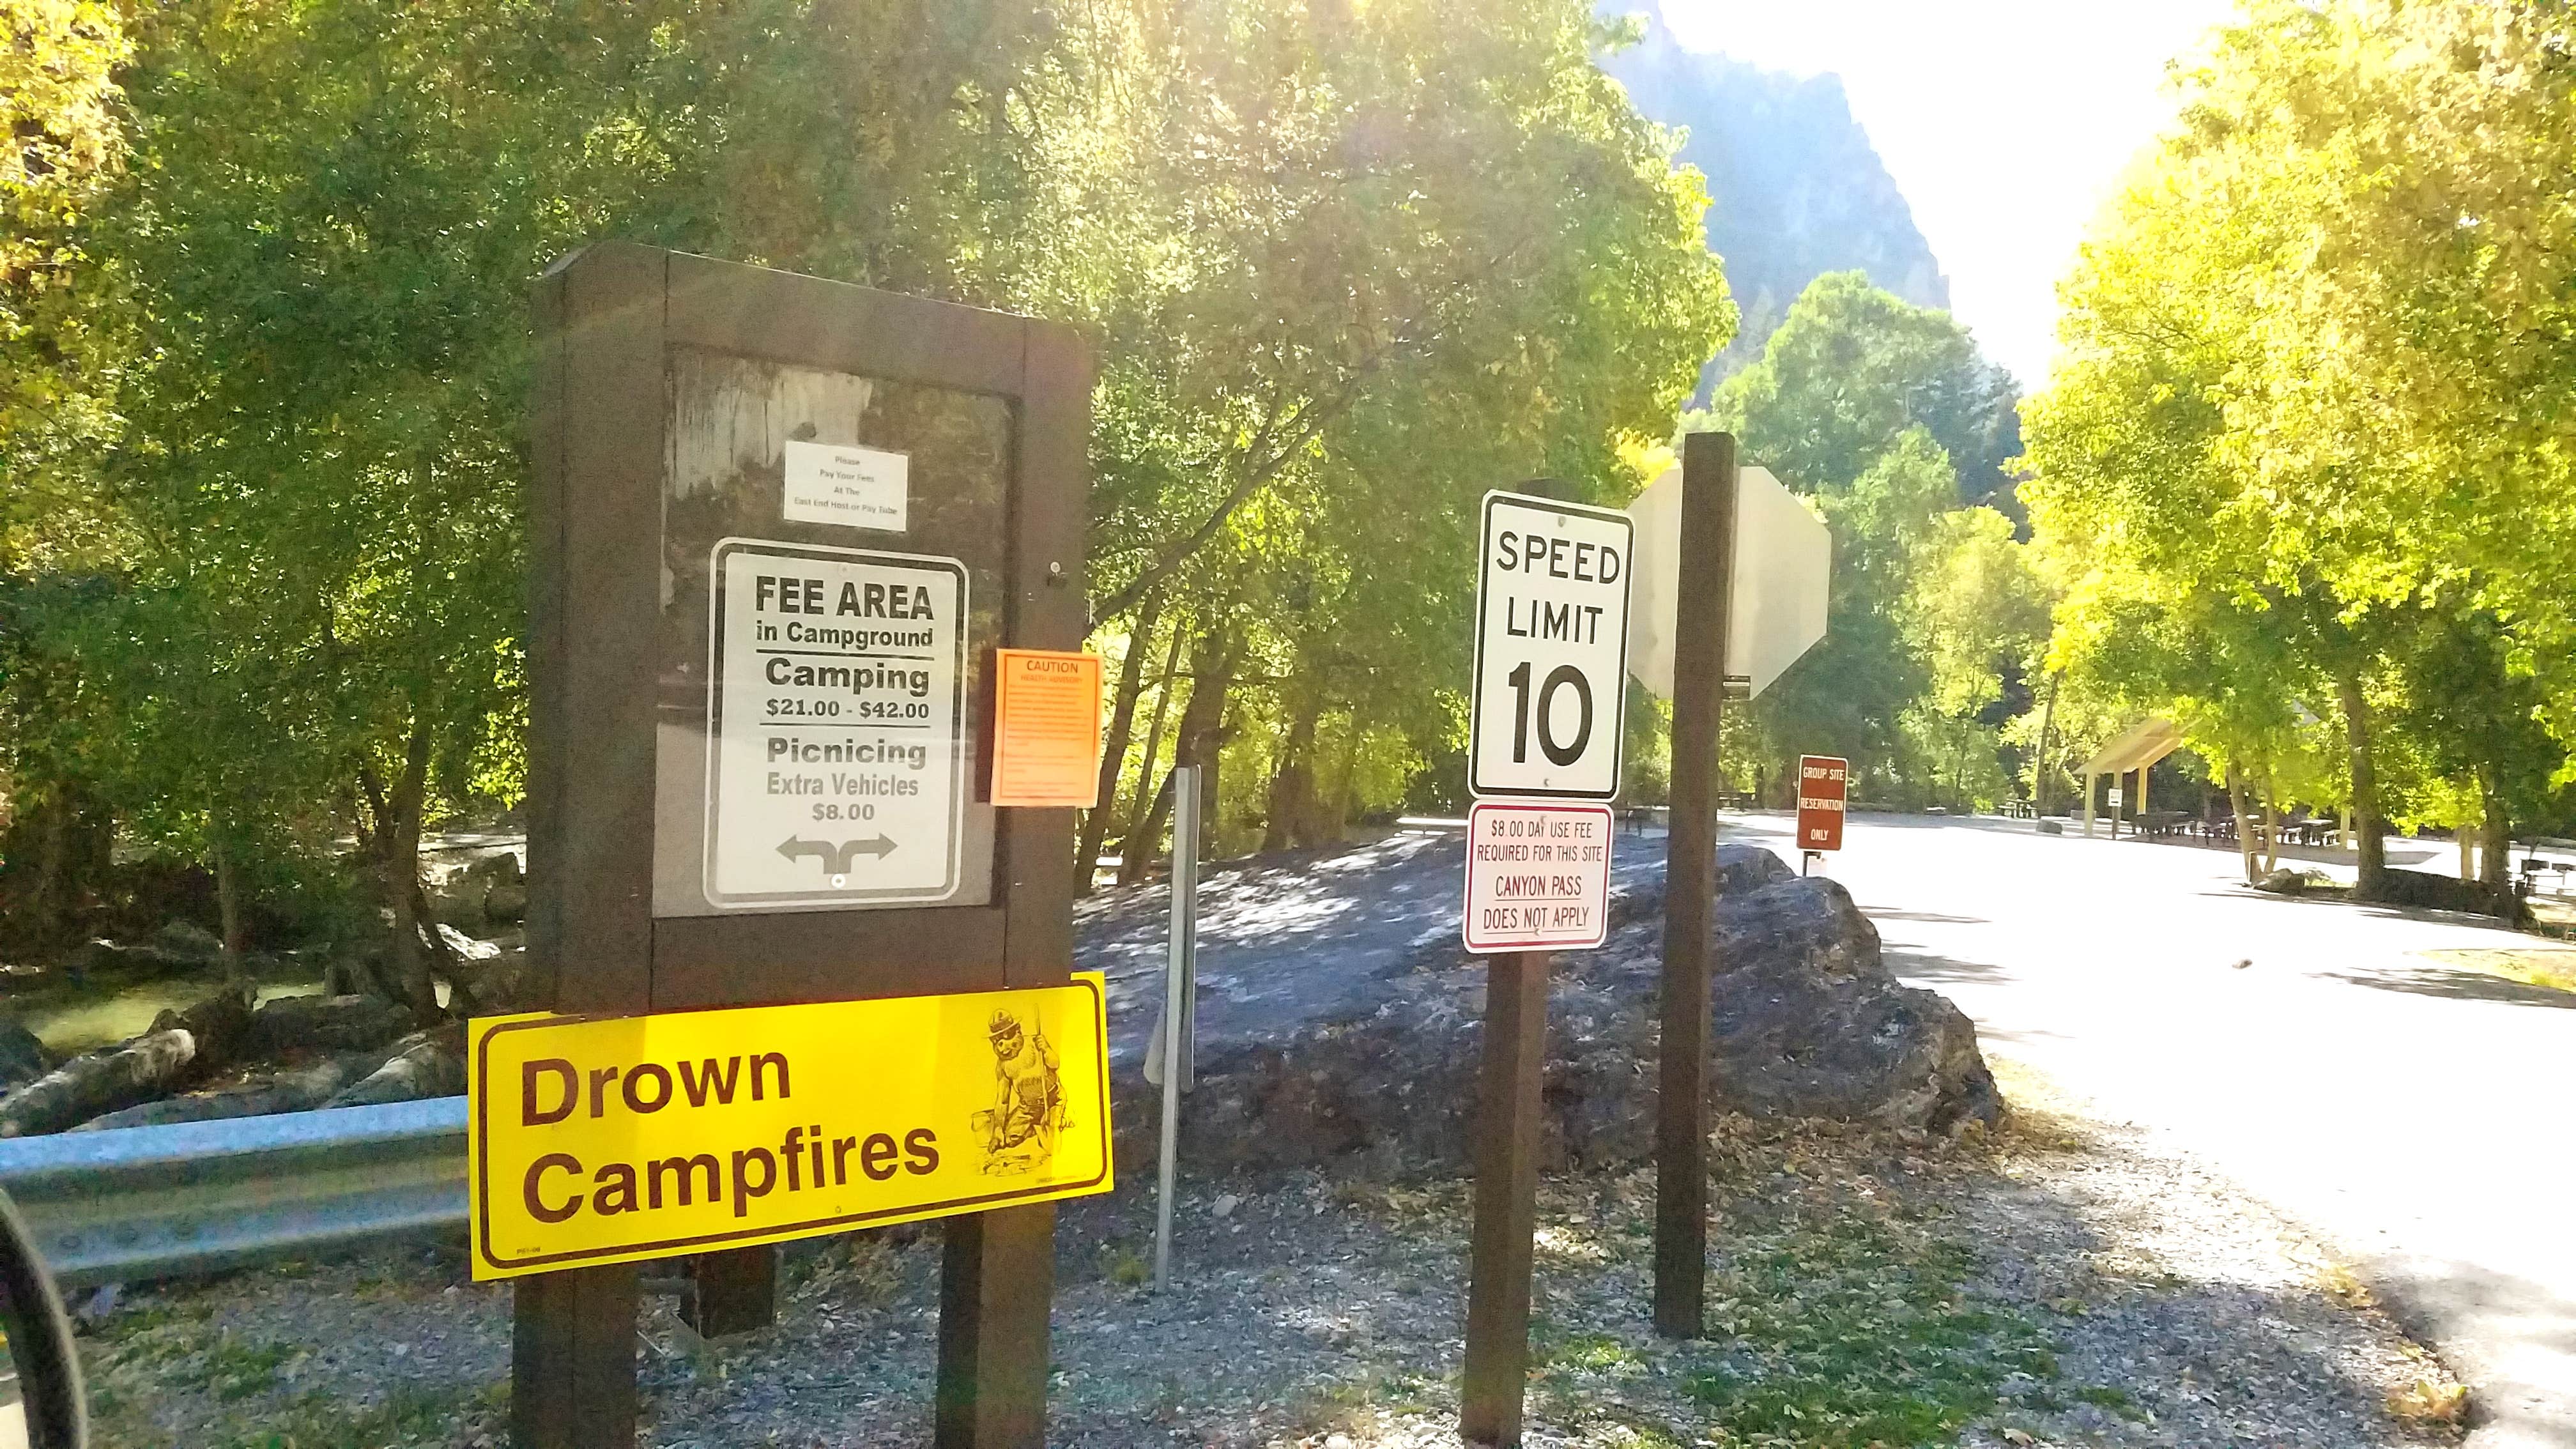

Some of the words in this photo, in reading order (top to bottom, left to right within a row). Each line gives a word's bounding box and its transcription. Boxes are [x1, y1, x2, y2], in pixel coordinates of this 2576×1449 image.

[835, 456, 860, 466] Please
[820, 469, 834, 479] Pay
[836, 471, 854, 480] Your
[857, 473, 874, 482] Fees
[834, 486, 843, 494] At
[846, 487, 860, 496] The
[794, 496, 811, 505] East
[813, 498, 829, 507] End
[831, 501, 848, 509] Host
[862, 505, 876, 514] Pay
[879, 505, 897, 515] Tube
[1496, 531, 1620, 584] SPEED
[756, 576, 824, 615] FEE
[836, 582, 935, 620] AREA
[1507, 596, 1603, 644] LIMIT
[756, 620, 778, 641] in
[786, 622, 933, 650] Campground
[765, 657, 930, 697] Camping
[1027, 660, 1078, 673] CAUTION
[766, 698, 840, 716] $21.00
[859, 703, 930, 719] $42.00
[1508, 662, 1593, 766] 10
[767, 737, 927, 770] Picnicing
[767, 772, 824, 796] Extra
[832, 774, 919, 797] Vehicles
[1803, 767, 1827, 779] GROUP
[1829, 769, 1844, 781] SITE
[812, 803, 875, 821] $8.00
[1800, 797, 1843, 811] RESERVATION
[1551, 822, 1570, 838] USE
[1574, 823, 1593, 838] FEE
[1811, 829, 1828, 841] ONLY
[1477, 845, 1528, 861] REQUIRED
[1533, 845, 1552, 861] FOR
[1557, 846, 1577, 862] THIS
[1582, 847, 1602, 862] SITE
[1496, 876, 1545, 896] CANYON
[1551, 875, 1582, 896] PASS
[1483, 908, 1517, 929] DOES
[1523, 907, 1547, 928] NOT
[1552, 906, 1590, 927] APPLY
[521, 1051, 791, 1126] Drown
[523, 1125, 940, 1223] Campfires
